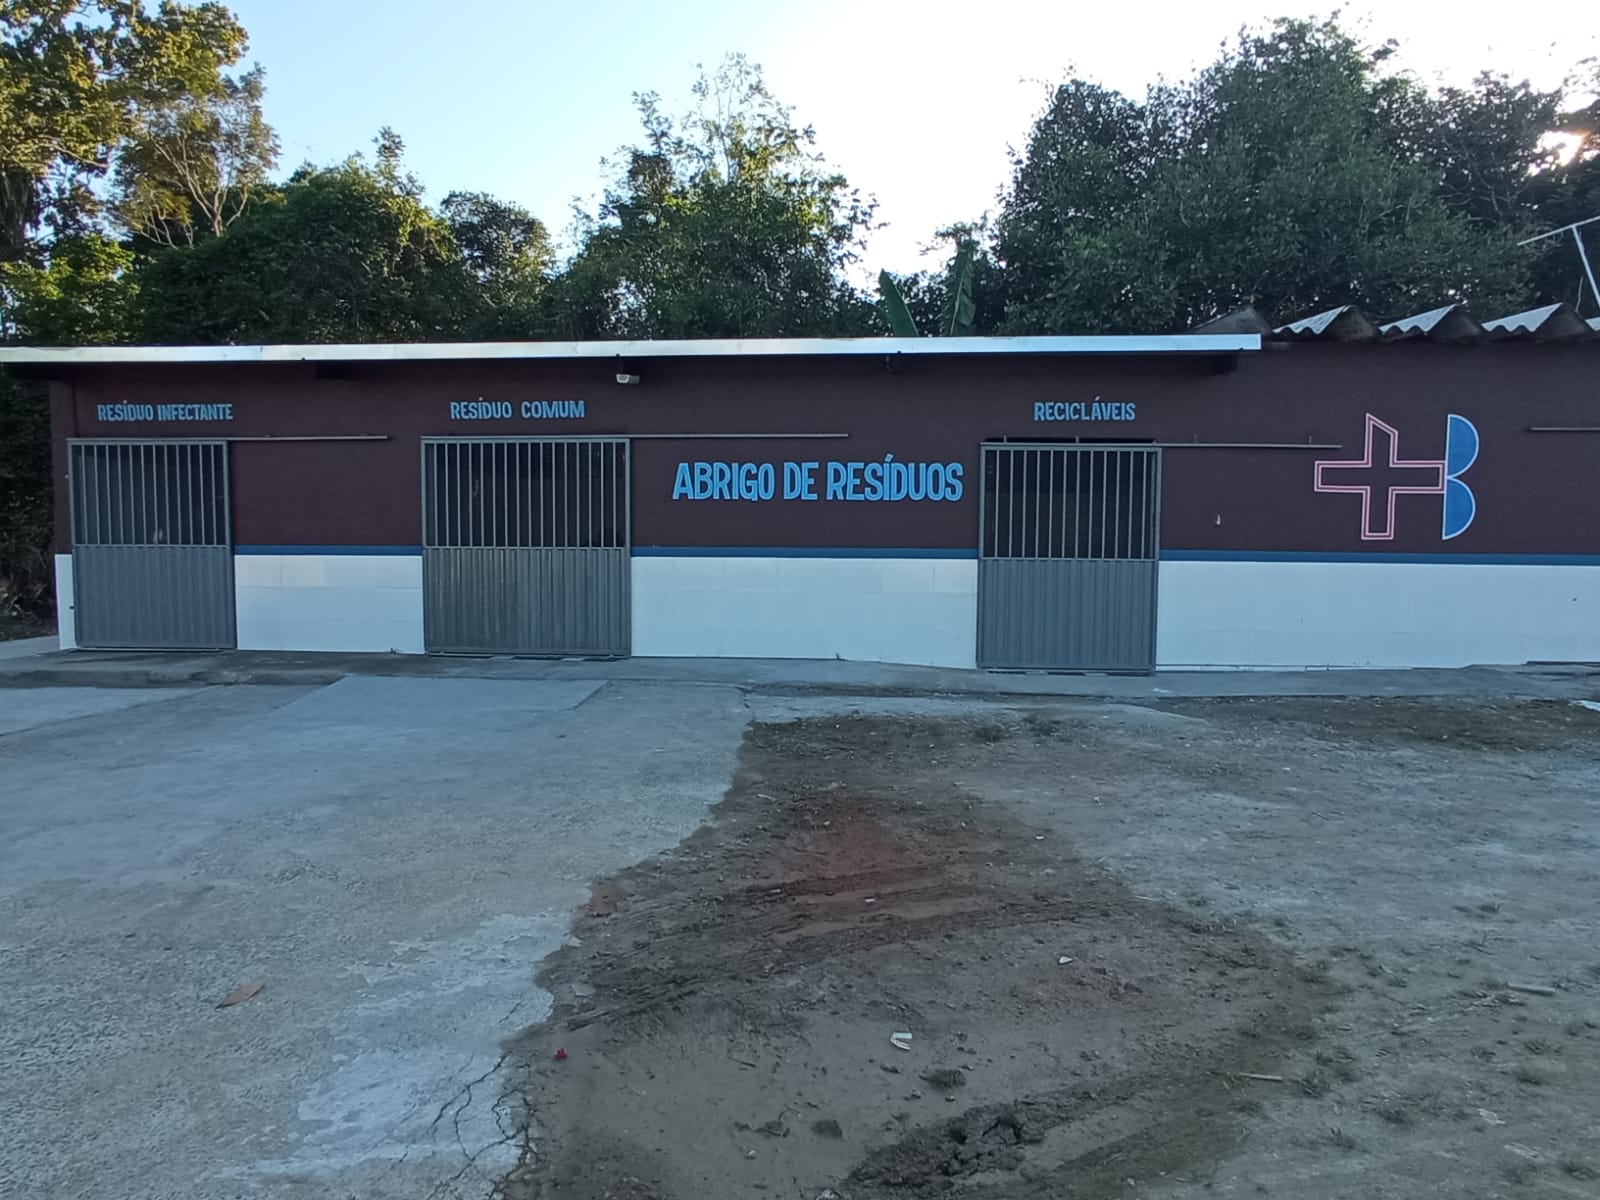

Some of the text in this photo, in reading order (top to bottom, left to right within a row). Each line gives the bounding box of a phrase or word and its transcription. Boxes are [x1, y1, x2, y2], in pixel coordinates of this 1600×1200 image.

[157, 404, 233, 421] INFECTANTE
[521, 400, 585, 419] COMUM
[1033, 396, 1136, 421] RECICLÁVEIS
[672, 453, 964, 502] ABRIGO DE RESÍDUOS
